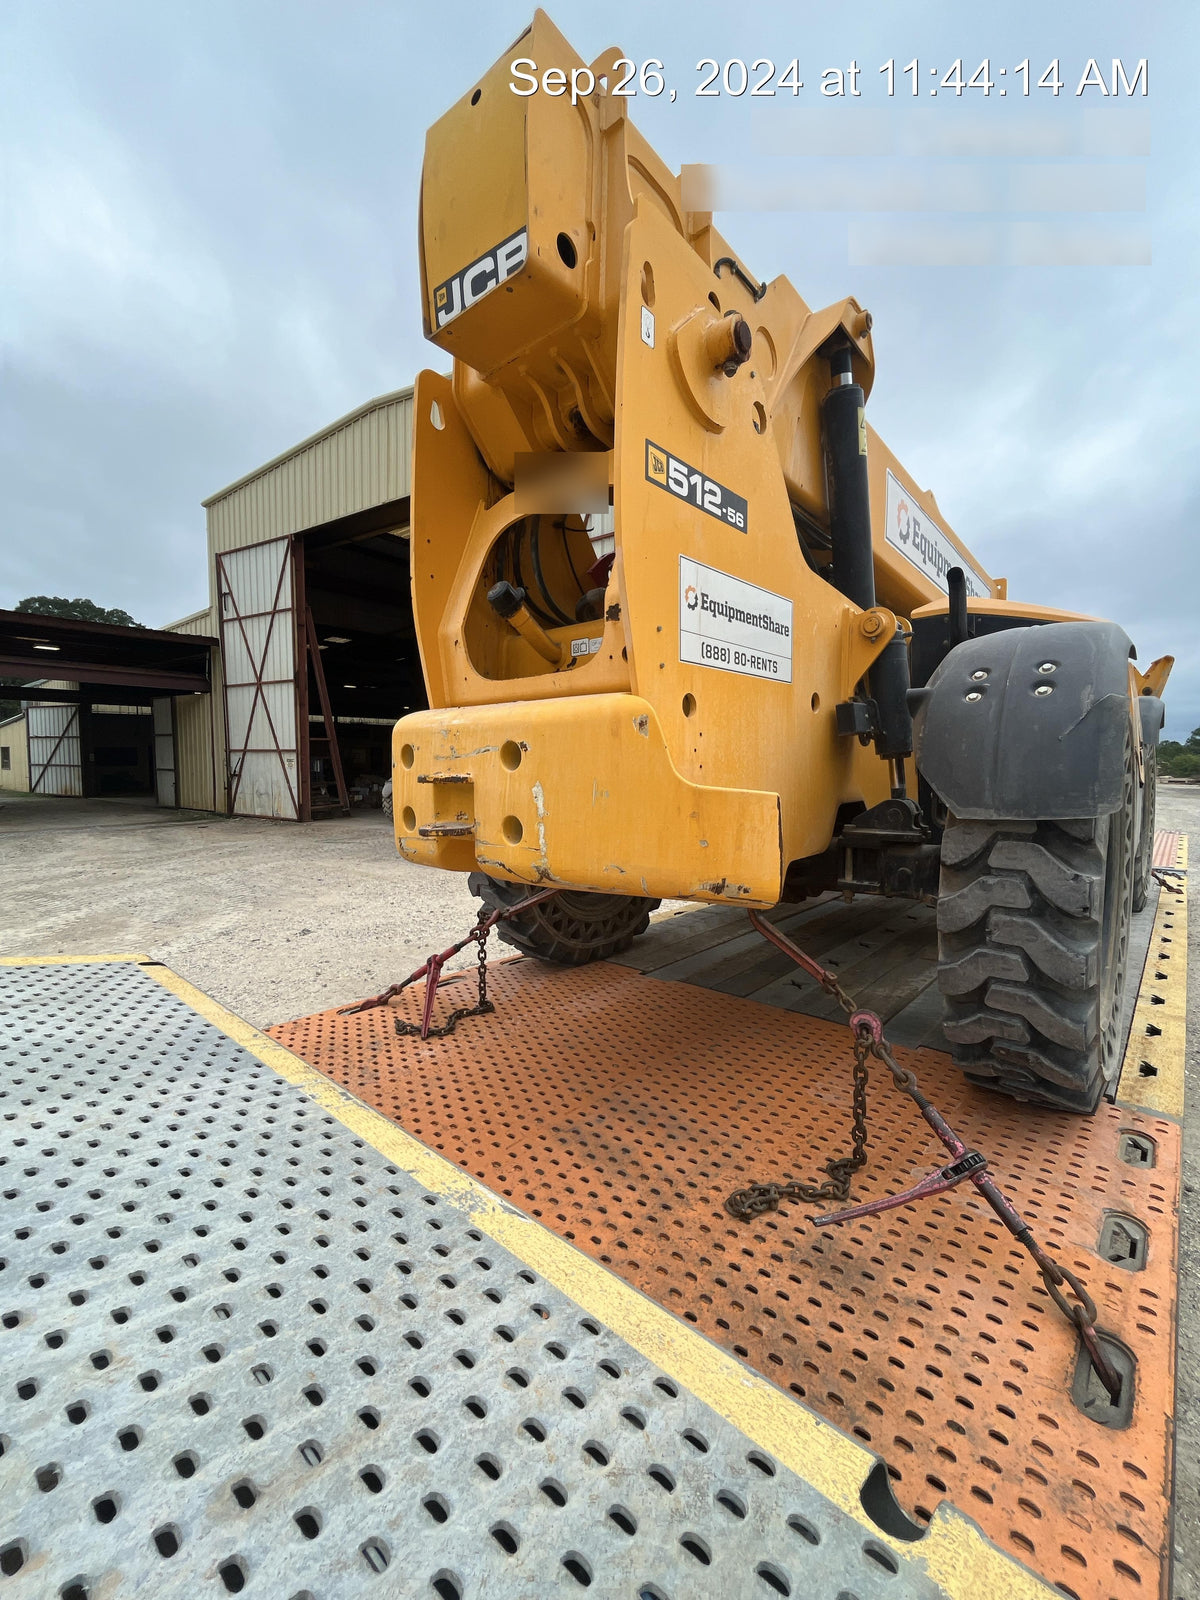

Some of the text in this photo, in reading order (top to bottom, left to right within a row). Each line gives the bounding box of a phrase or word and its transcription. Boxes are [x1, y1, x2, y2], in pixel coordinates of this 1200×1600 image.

[700, 592, 790, 637] EquipmentShare
[701, 641, 778, 673] (888) 80-RENTS
